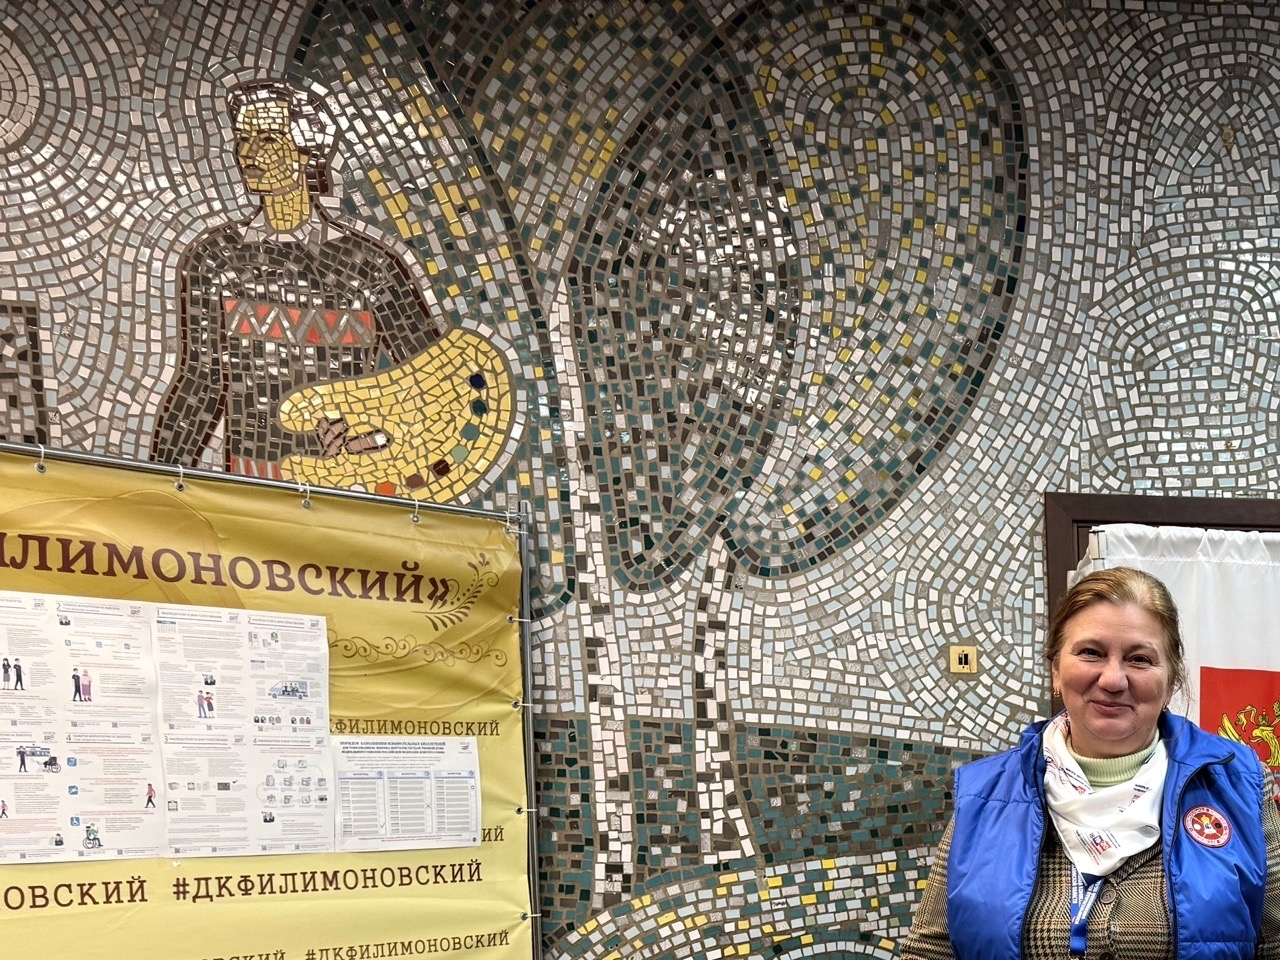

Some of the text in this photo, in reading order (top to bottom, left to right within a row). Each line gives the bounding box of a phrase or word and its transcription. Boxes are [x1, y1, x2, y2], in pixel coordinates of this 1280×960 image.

[329, 719, 500, 736] ФИЛИМОНОВСКИЙ
[4, 858, 483, 910] ОВСКИЙ #ДКФИЛИМОНОВСКИЙ
